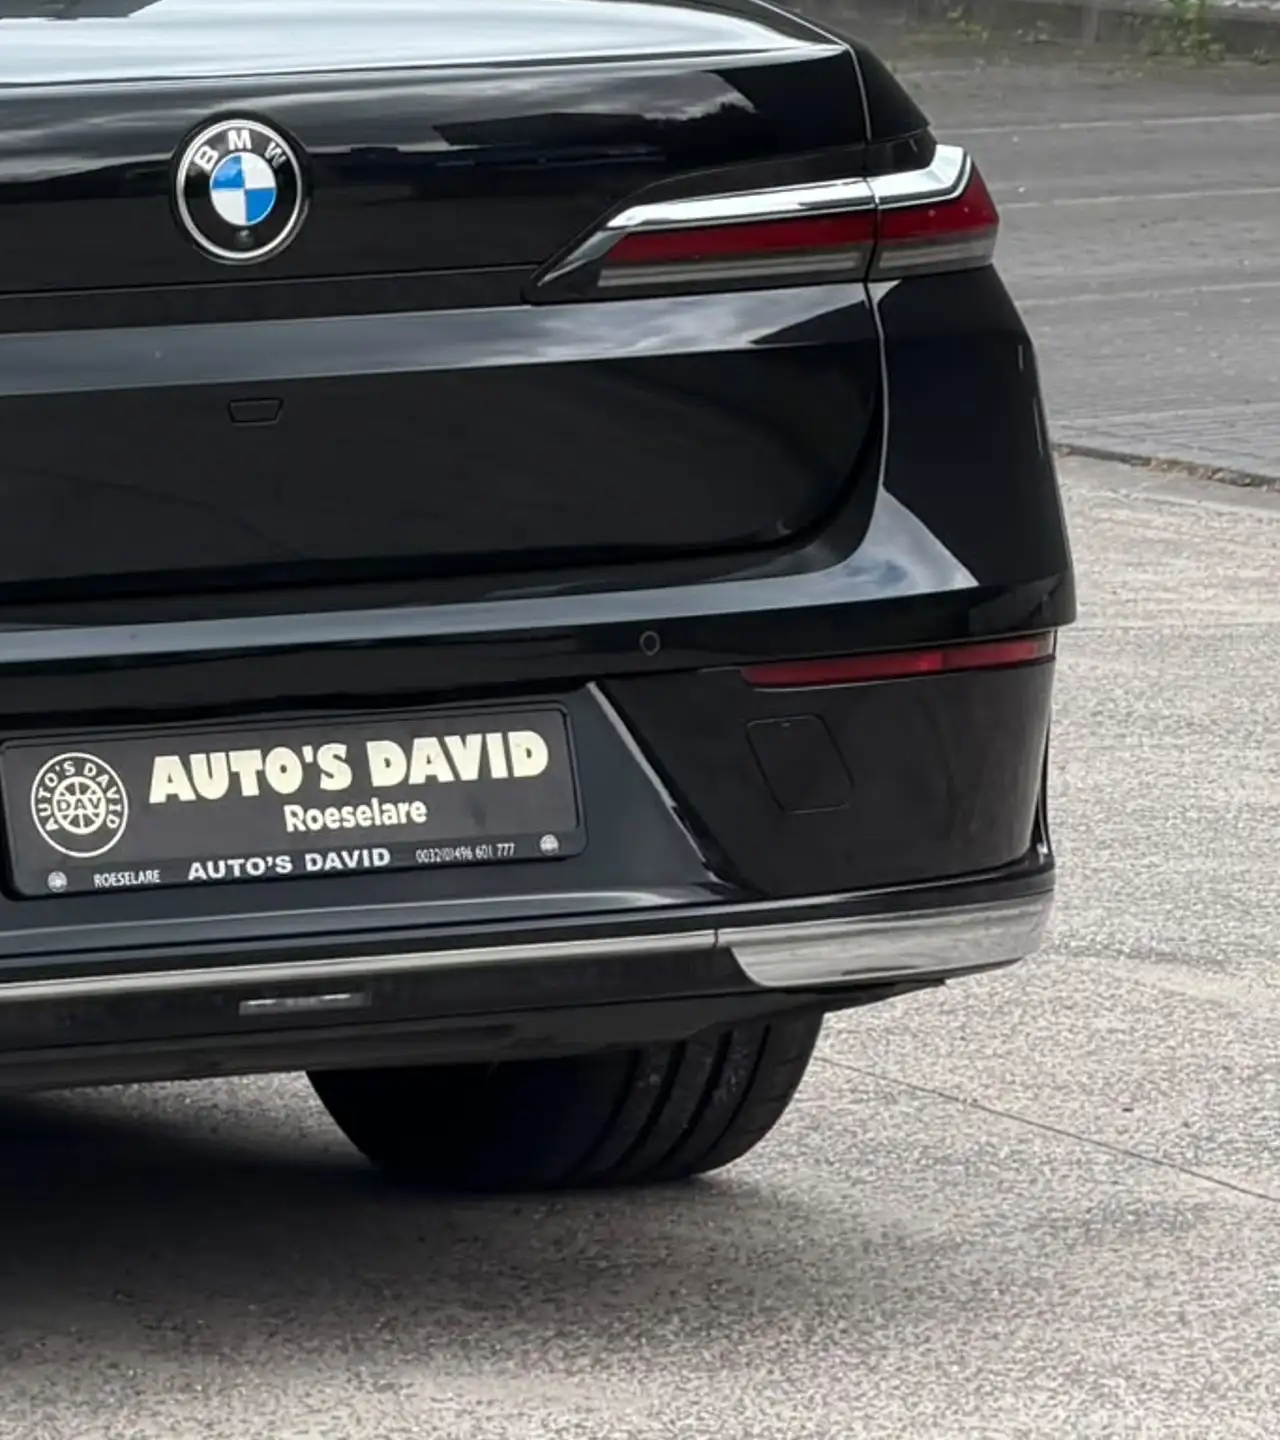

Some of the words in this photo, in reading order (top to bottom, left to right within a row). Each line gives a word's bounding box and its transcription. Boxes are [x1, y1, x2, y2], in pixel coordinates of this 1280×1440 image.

[193, 128, 288, 173] BMW
[148, 744, 353, 803] AUTO'S
[367, 729, 549, 788] DAVID
[37, 761, 76, 831] AUTO'S
[83, 762, 122, 829] DAVID
[55, 796, 103, 814] DAV
[283, 797, 428, 833] Roeselare
[93, 869, 161, 888] ROESELARE
[188, 854, 293, 881] AUTO'S
[304, 847, 391, 872] DAVID
